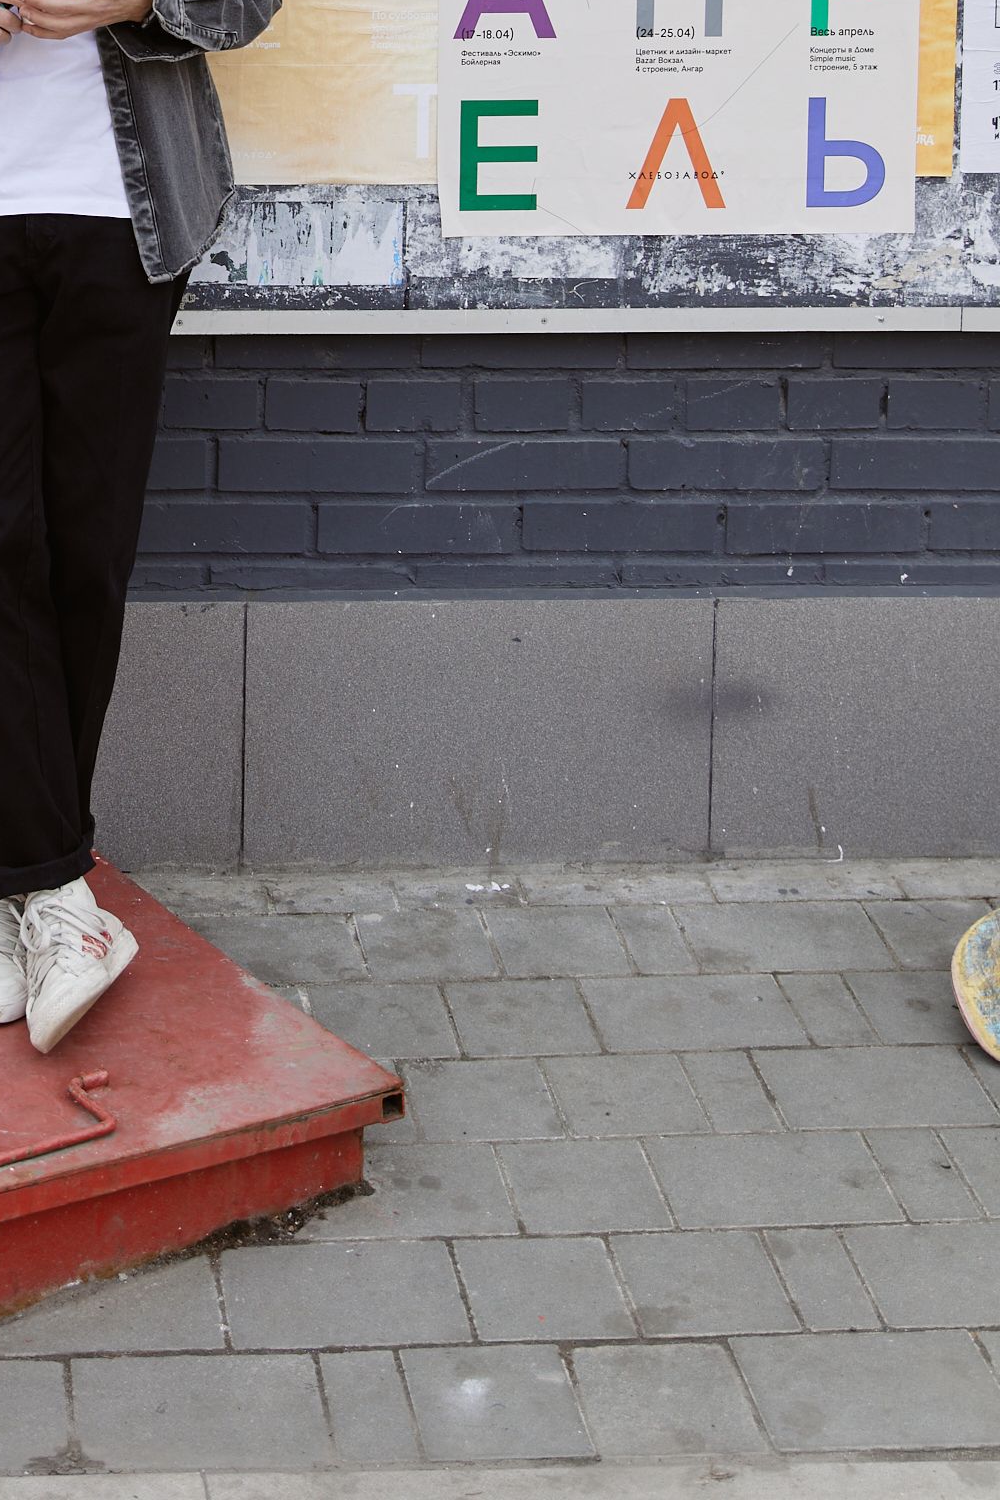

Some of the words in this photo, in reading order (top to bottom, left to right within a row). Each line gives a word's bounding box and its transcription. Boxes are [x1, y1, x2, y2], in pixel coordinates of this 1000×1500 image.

[461, 28, 514, 41] (17-18.04)
[636, 27, 695, 40] (24-25.04)
[810, 27, 836, 37] Весь
[838, 28, 875, 38] апрель
[461, 50, 502, 58] Фестиваль
[636, 48, 668, 56] Цветник
[809, 46, 847, 54] Концерты
[461, 58, 501, 66] Бойлерная
[809, 55, 834, 63] Simple
[642, 66, 679, 74] строение,
[681, 66, 704, 74] Ангар
[813, 64, 851, 72] строение,
[459, 99, 538, 211] Е
[626, 98, 726, 209] Л
[806, 97, 885, 207] Ь
